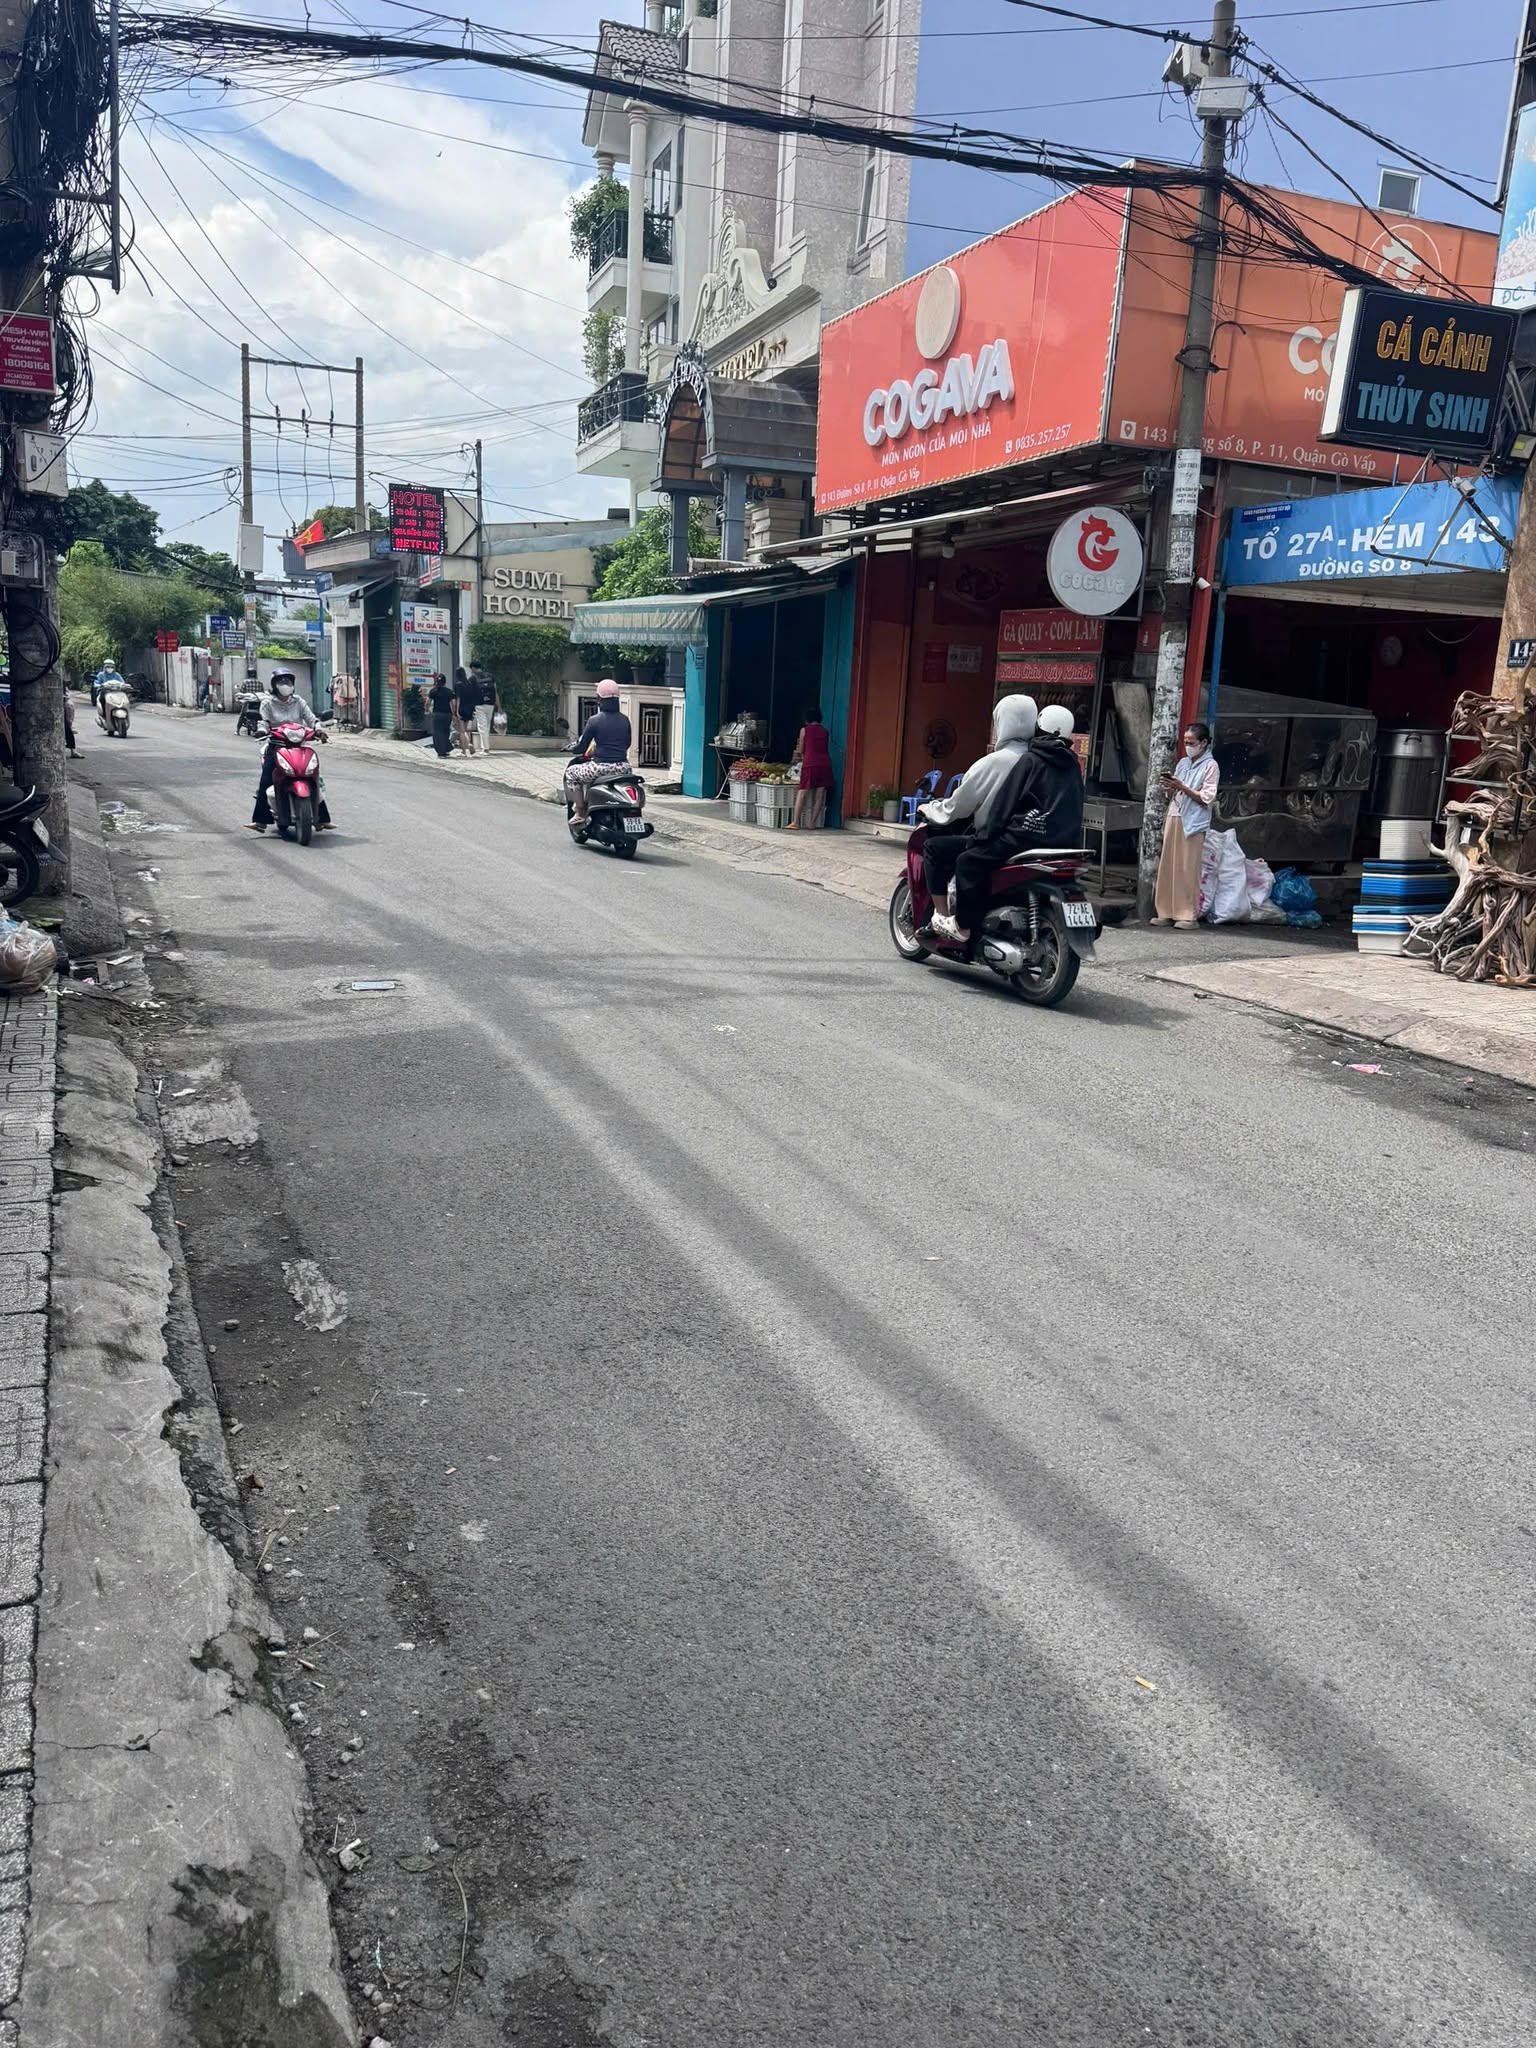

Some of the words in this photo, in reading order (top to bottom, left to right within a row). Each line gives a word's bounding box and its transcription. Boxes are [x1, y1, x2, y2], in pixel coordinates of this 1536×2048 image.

[1377, 315, 1413, 362] CÁ
[1418, 317, 1493, 373] CẢNH
[863, 338, 1015, 447] COGAVA
[1356, 374, 1423, 425] THỦY
[1426, 391, 1490, 433] SINH
[882, 445, 899, 467] MÓN
[903, 443, 926, 461] NGON
[929, 432, 946, 453] CỦA
[949, 429, 968, 449] MỌI
[971, 421, 992, 440] NHÀ
[1143, 426, 1168, 442] 143
[1293, 446, 1327, 466] Quận
[1331, 452, 1349, 467] Gò
[1353, 453, 1377, 474] Vấp
[393, 491, 441, 508] HOTEL
[395, 538, 439, 551] NETFLIX
[1243, 526, 1280, 560] TỔ
[494, 567, 564, 592] SUMI
[1299, 557, 1364, 576] ĐƯỜNG
[483, 593, 575, 619] HOTEL
[1018, 623, 1045, 645] QUAY
